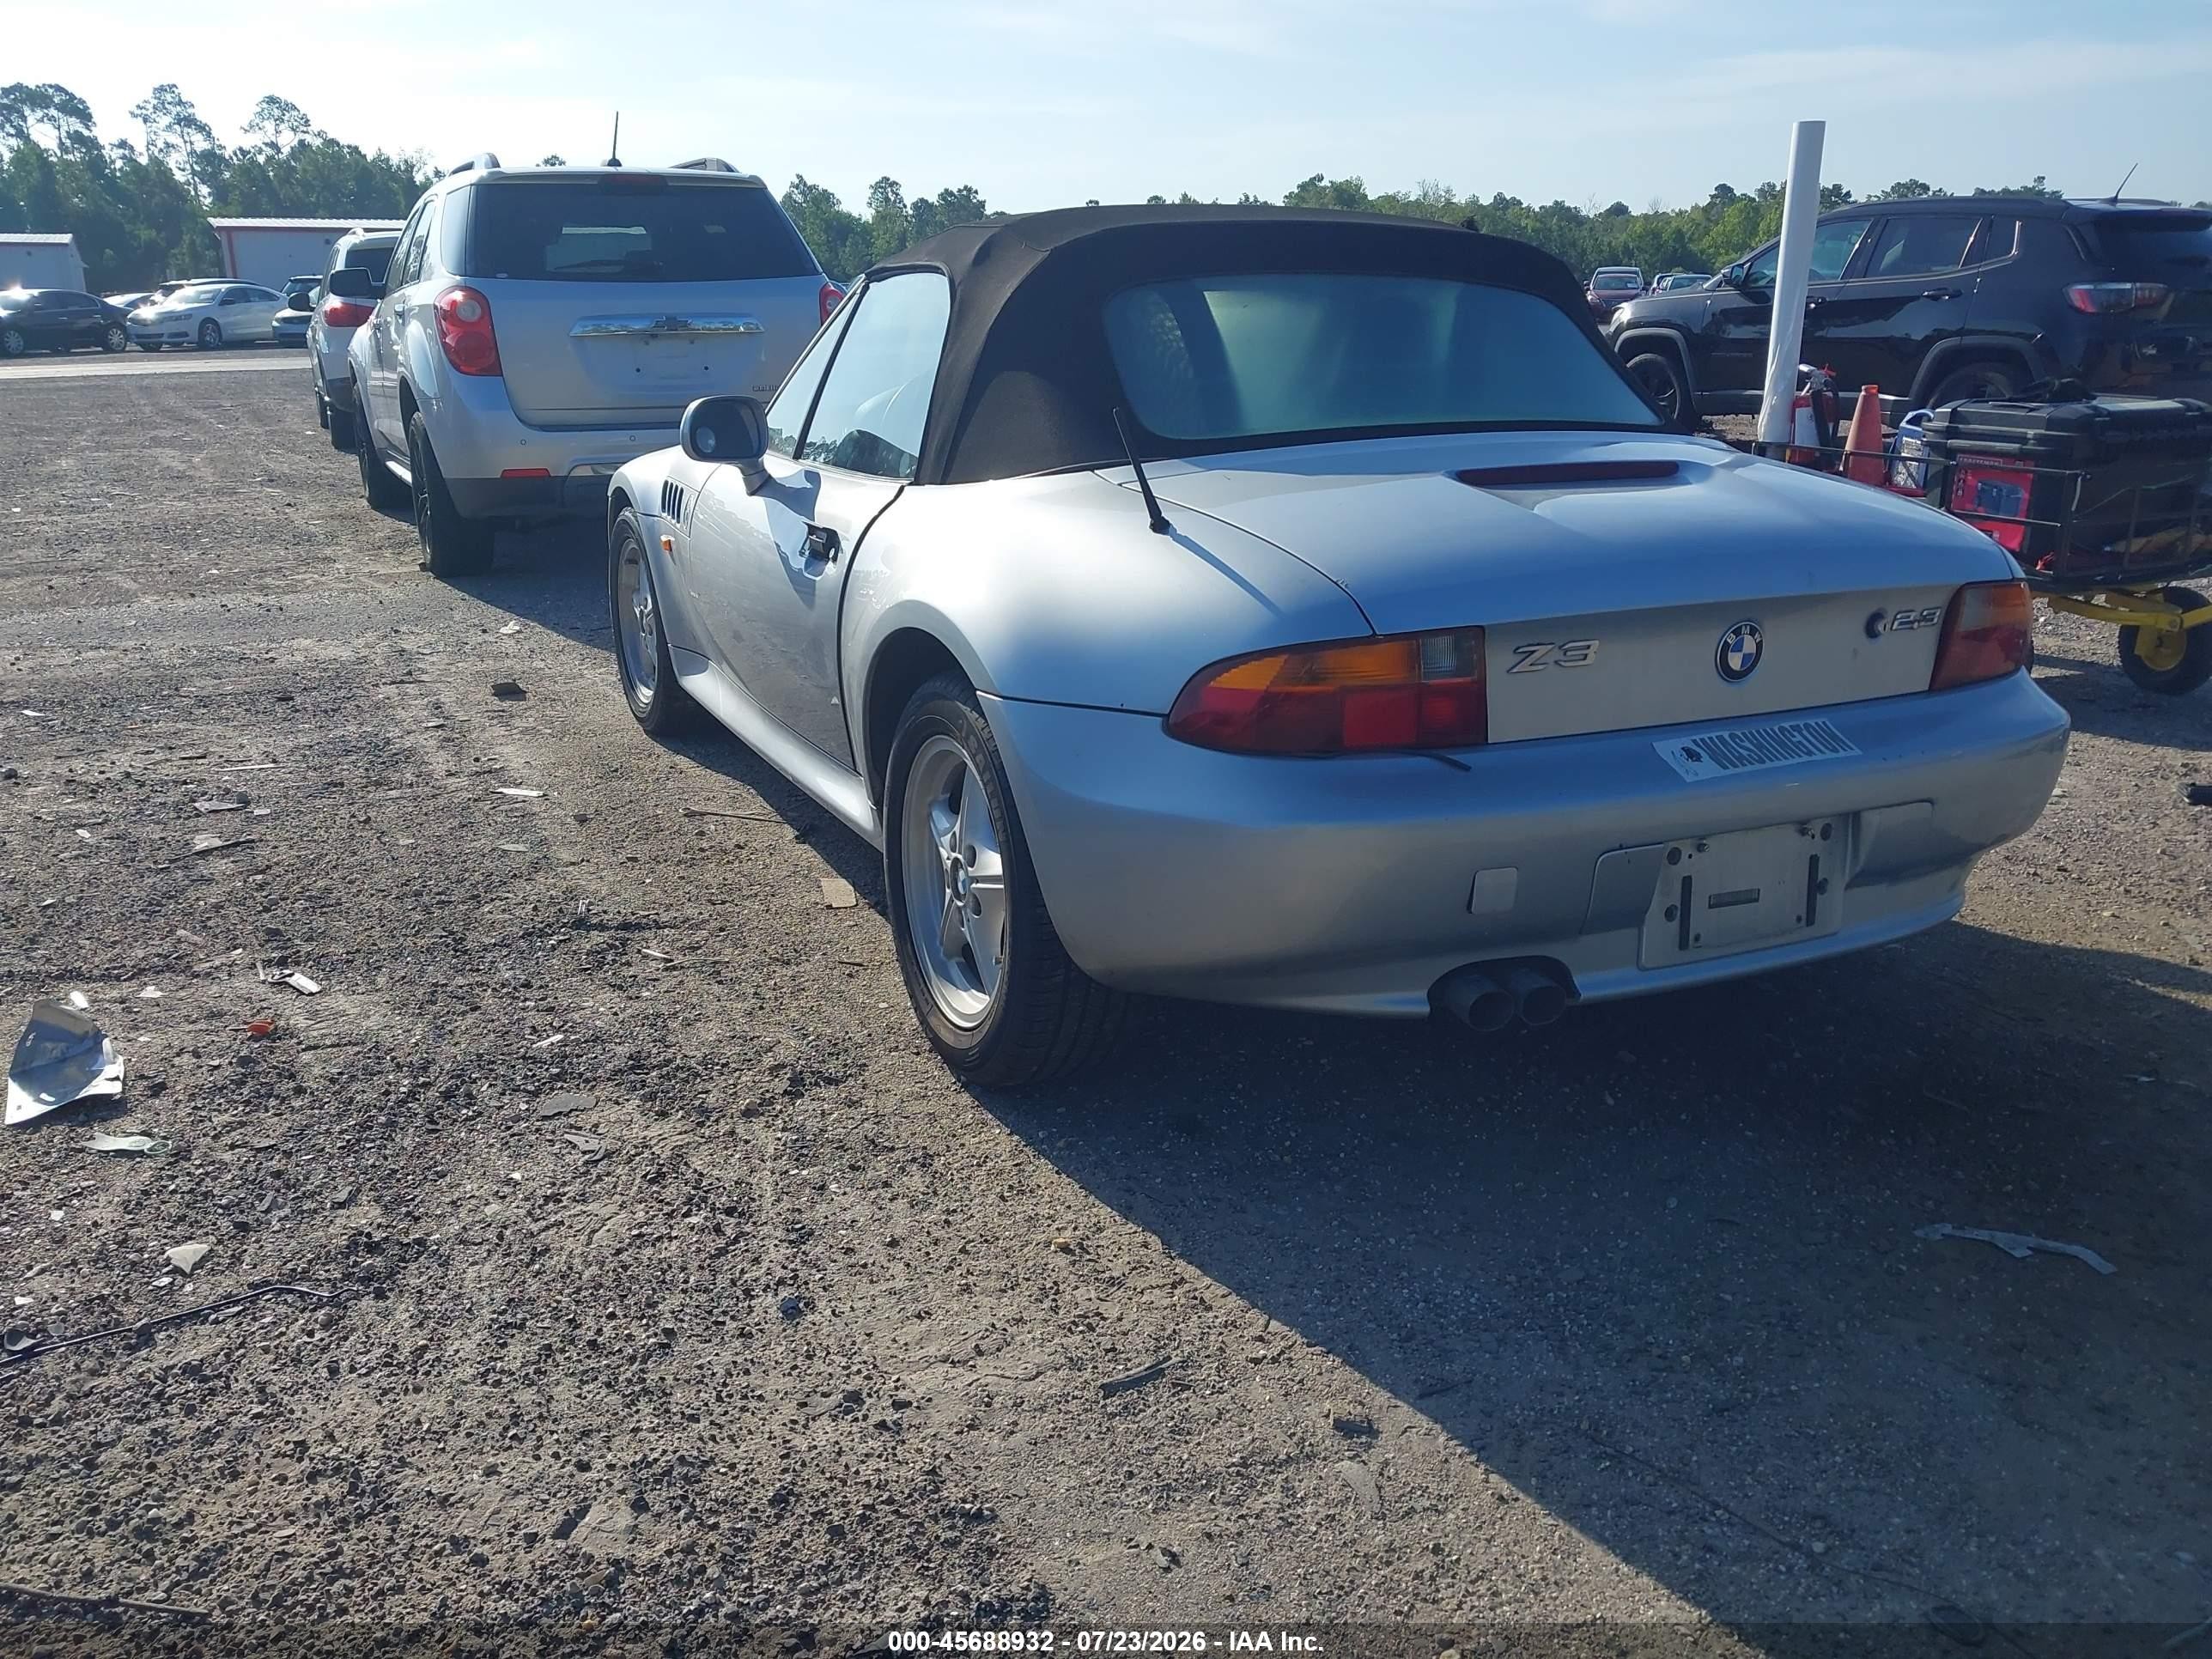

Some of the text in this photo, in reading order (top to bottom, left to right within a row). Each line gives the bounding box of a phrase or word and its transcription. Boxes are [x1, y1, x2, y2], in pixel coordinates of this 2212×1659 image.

[1726, 625, 1763, 644] BMW
[1506, 639, 1599, 673] Z3
[1691, 720, 1855, 770] WASHINGTON
